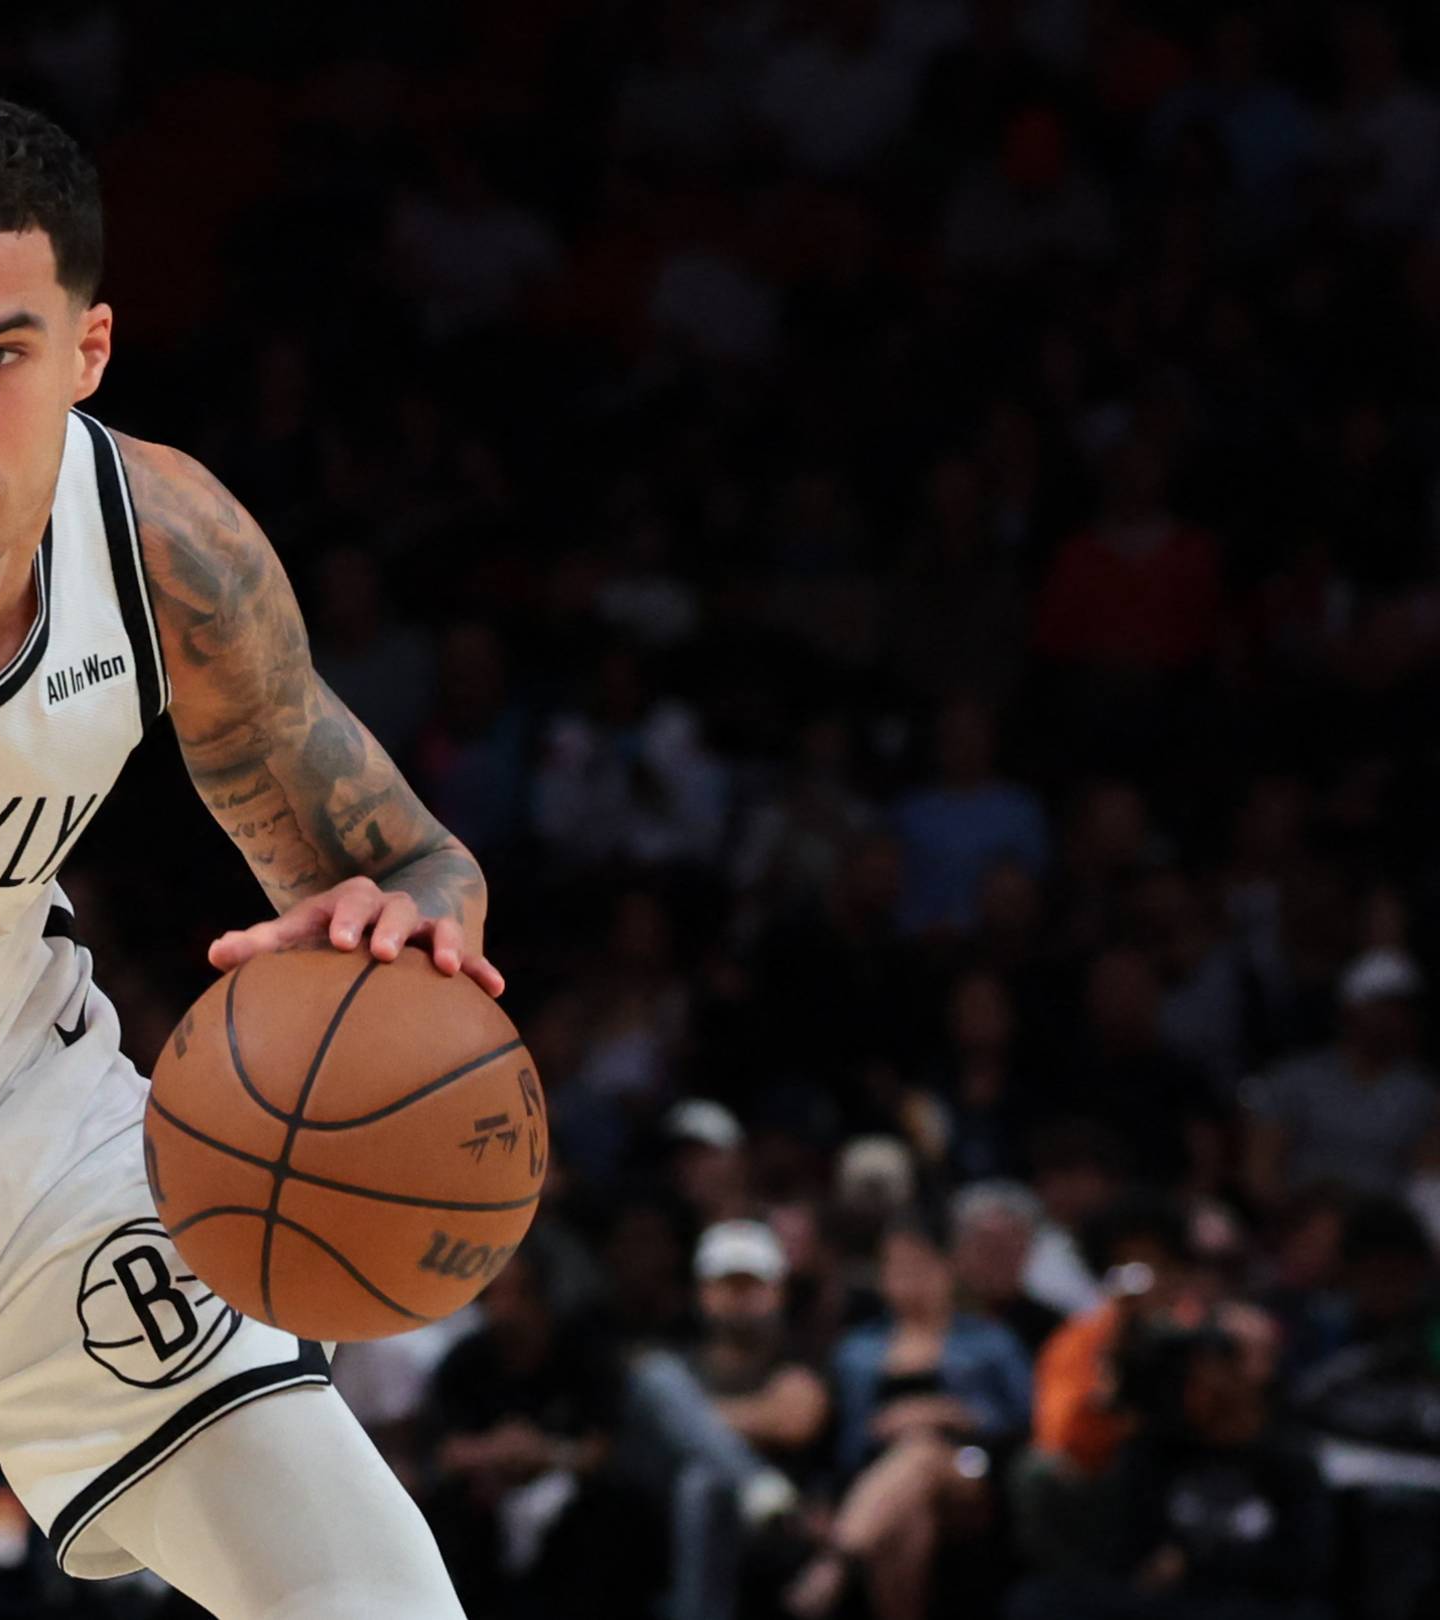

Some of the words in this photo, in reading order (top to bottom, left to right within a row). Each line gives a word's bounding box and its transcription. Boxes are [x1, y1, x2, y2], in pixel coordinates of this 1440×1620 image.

[46, 671, 69, 706] All
[69, 666, 85, 694] In
[82, 653, 126, 686] Won
[112, 1244, 199, 1362] B
